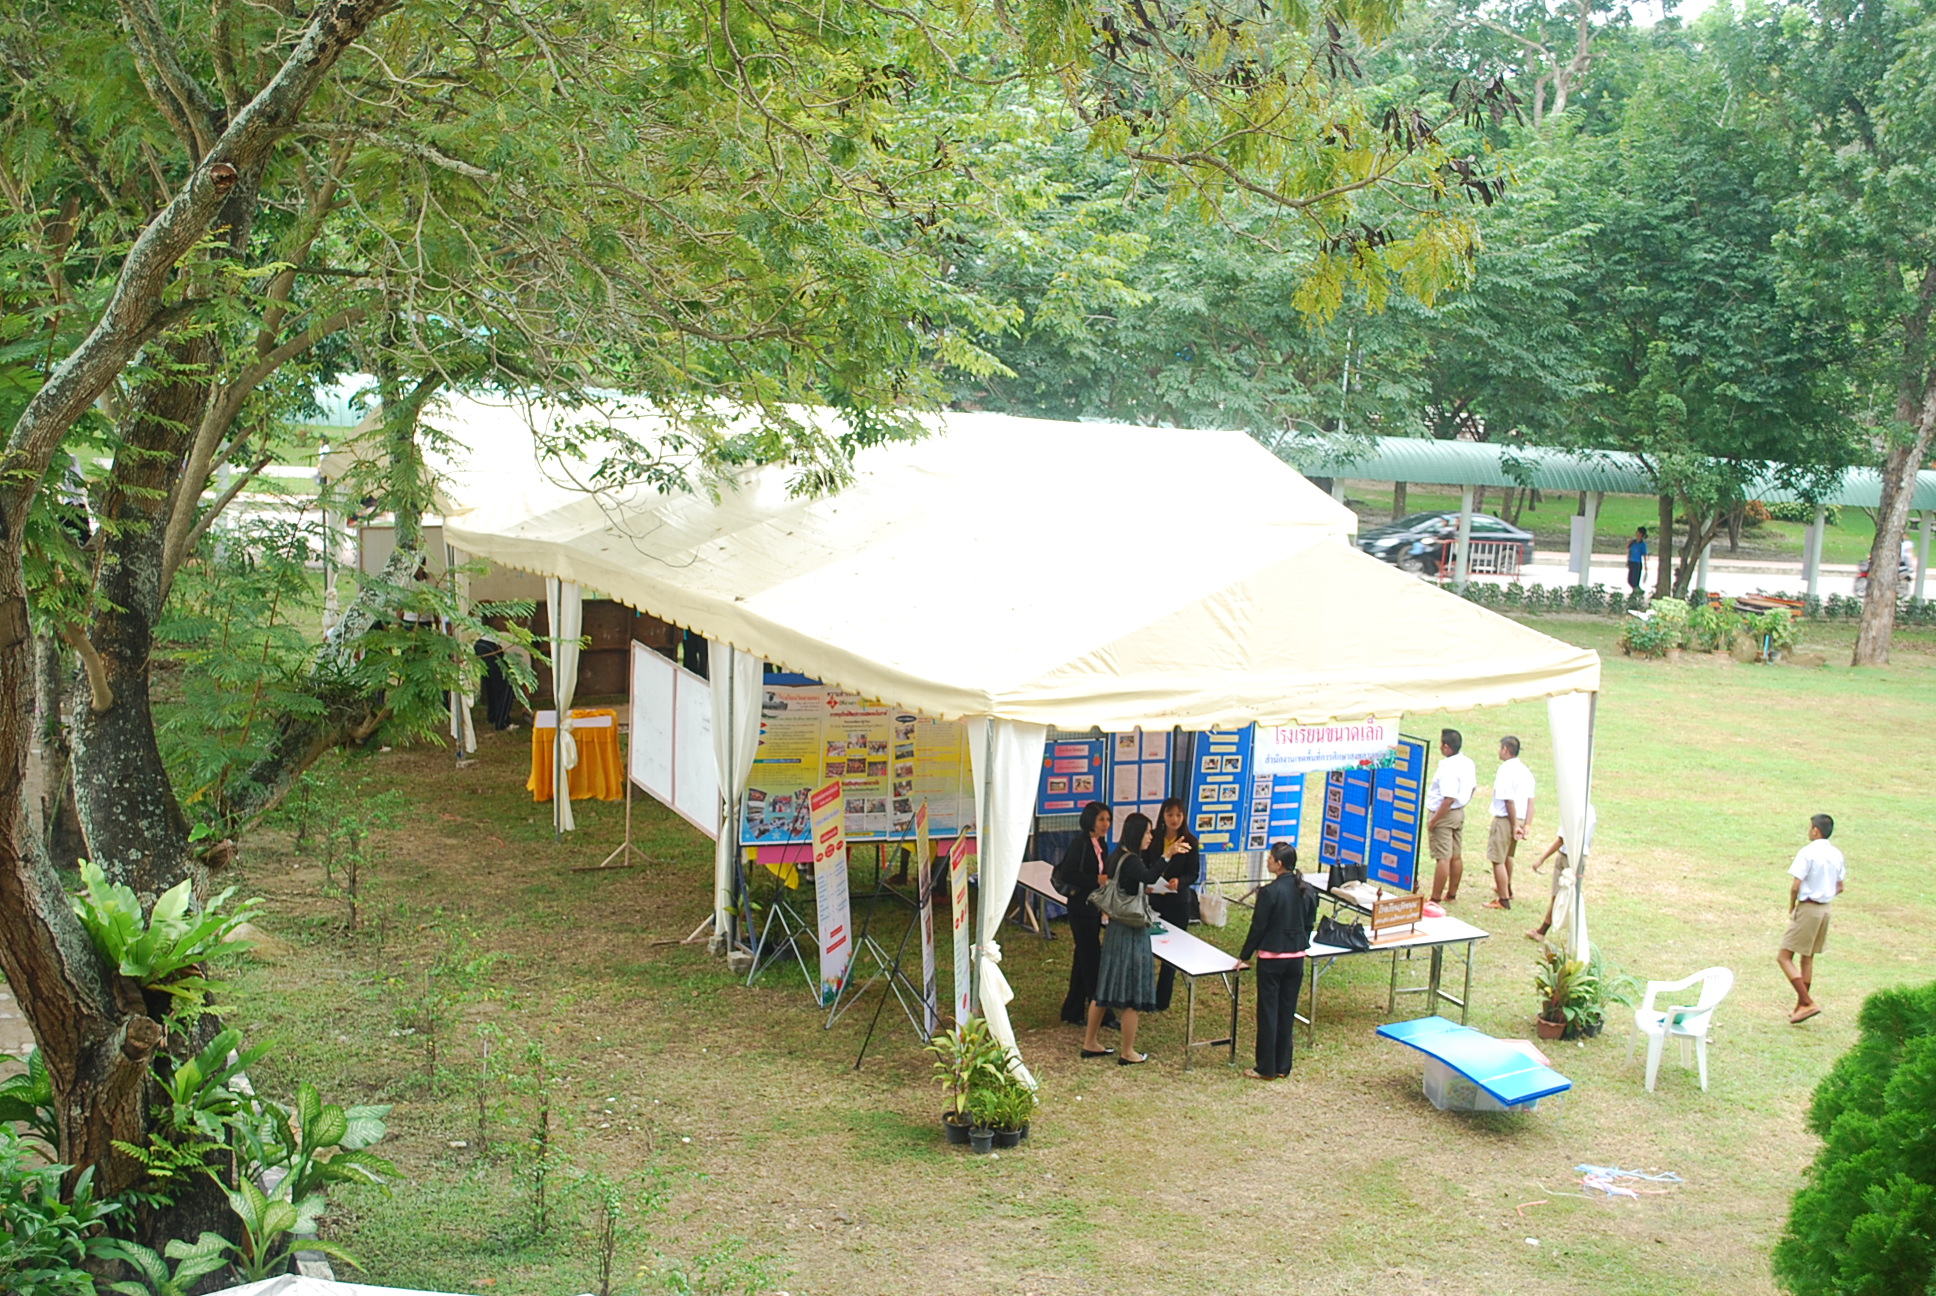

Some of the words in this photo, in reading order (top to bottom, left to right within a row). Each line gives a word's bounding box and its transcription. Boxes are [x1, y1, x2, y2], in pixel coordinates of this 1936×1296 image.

[1275, 715, 1383, 744] โรงเรยนขนาดเล็ก
